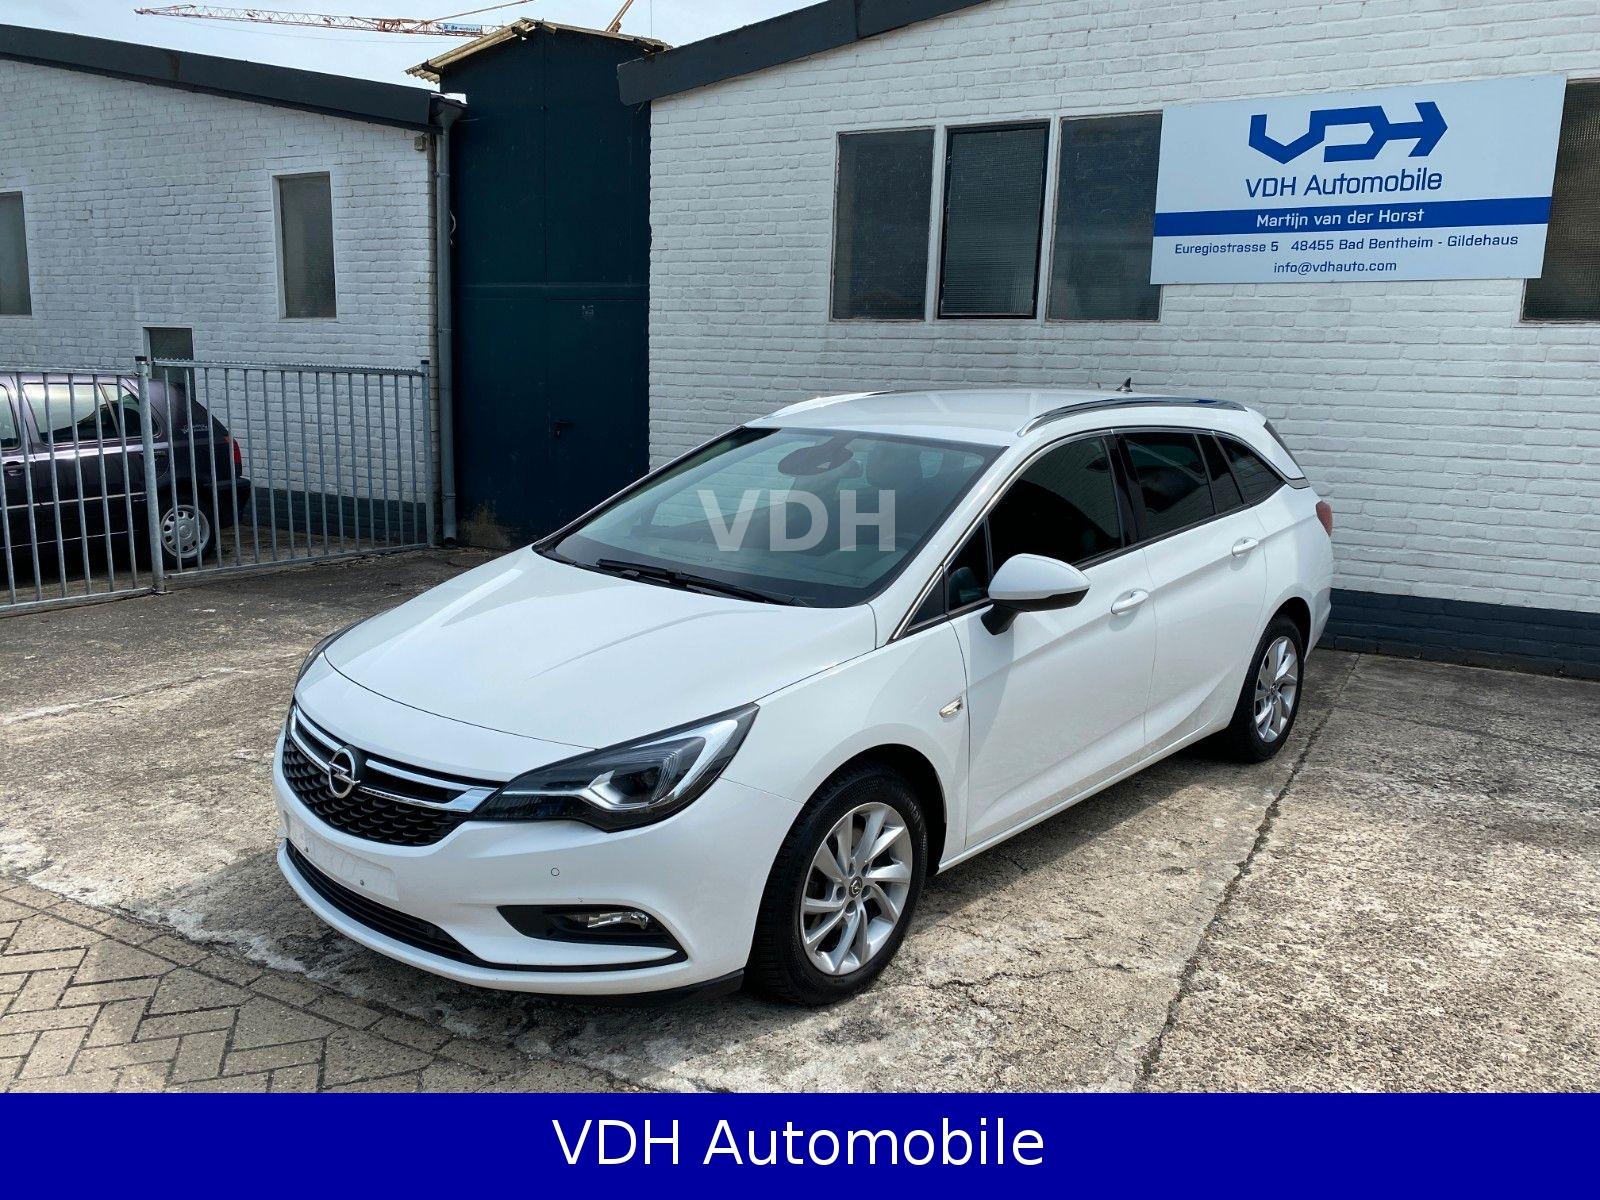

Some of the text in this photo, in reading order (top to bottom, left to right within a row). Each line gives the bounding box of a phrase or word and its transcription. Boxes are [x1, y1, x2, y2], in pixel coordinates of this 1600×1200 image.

[1245, 167, 1443, 198] VDH Automobile
[1256, 209, 1425, 229] Martijn van der Horst
[1174, 241, 1267, 257] Euregiostrasse
[1270, 240, 1280, 252] 5
[1290, 239, 1335, 252] 48455
[1338, 238, 1365, 250] Bad
[1368, 237, 1434, 250] Bentheim
[1447, 234, 1519, 247] Gildehaus
[1273, 260, 1397, 276] info@vdhauto.com
